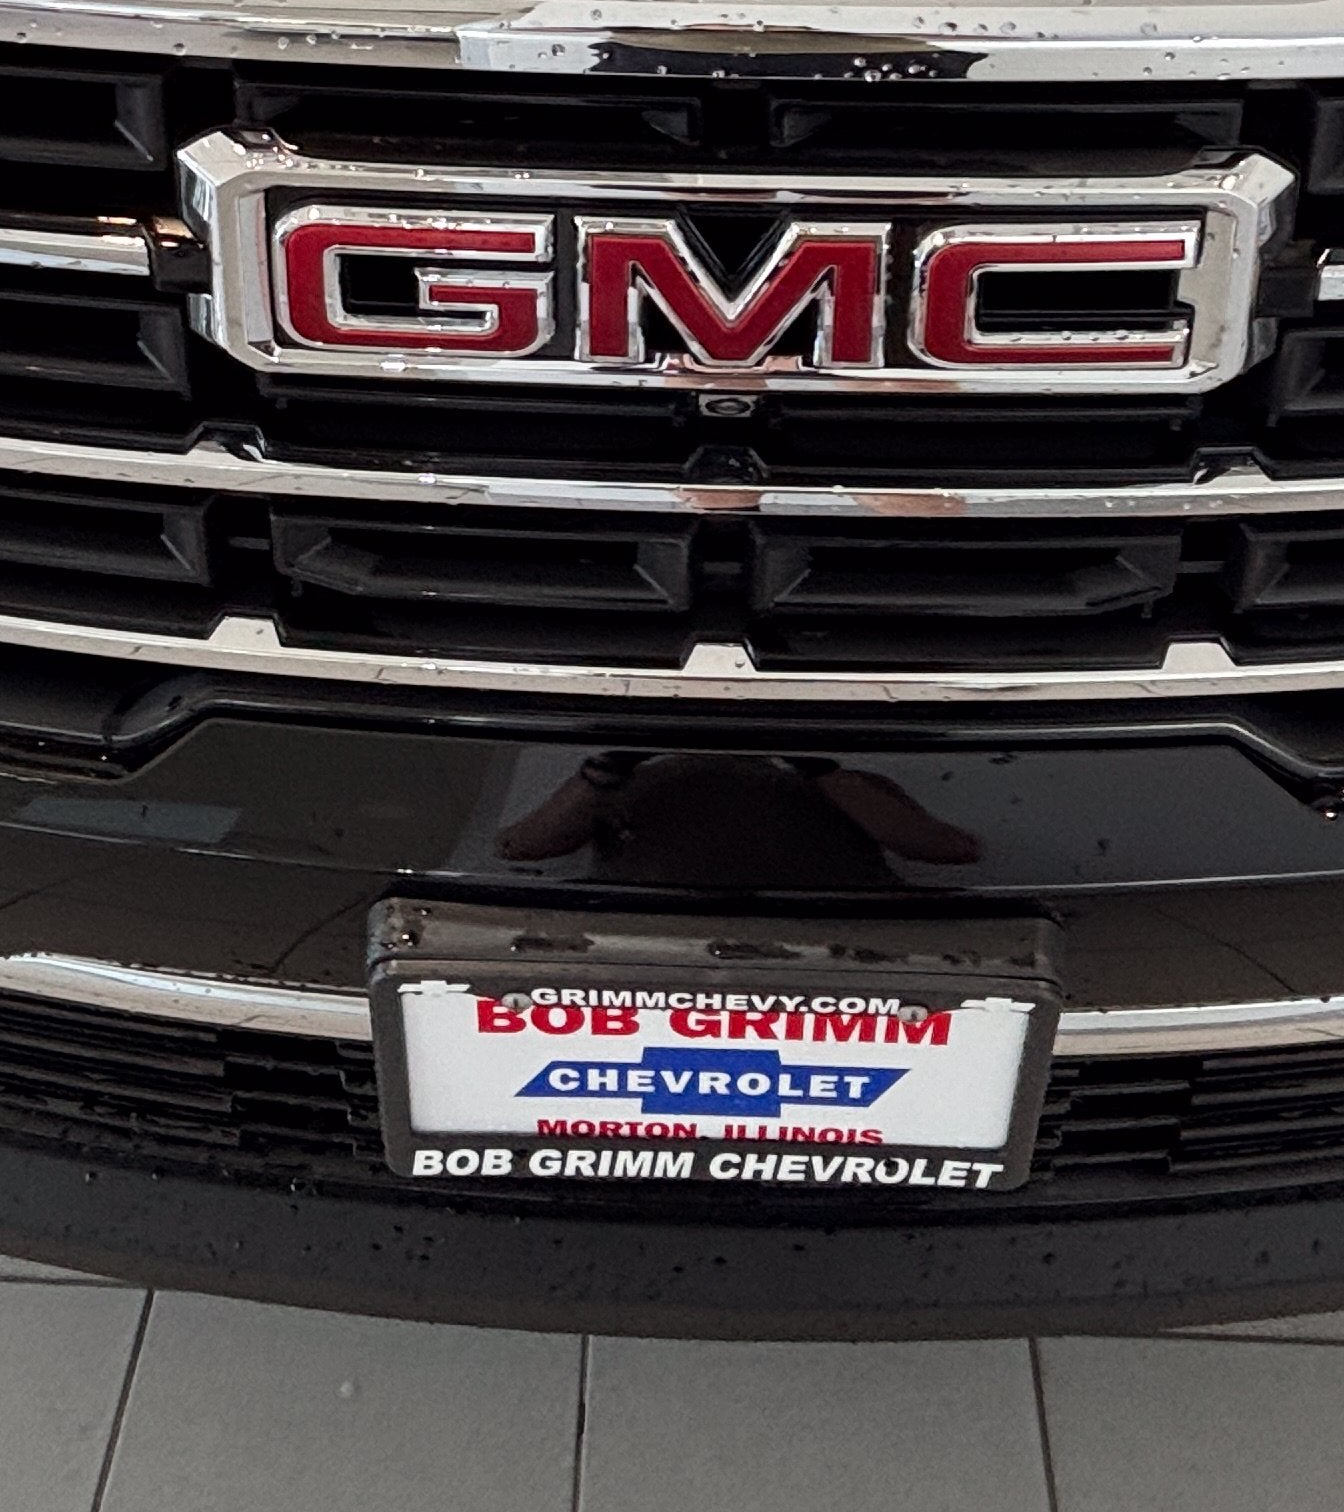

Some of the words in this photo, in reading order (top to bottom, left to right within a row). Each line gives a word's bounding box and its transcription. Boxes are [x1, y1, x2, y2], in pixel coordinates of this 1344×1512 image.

[272, 203, 1203, 370] GMC
[530, 987, 900, 1016] GRIMMCHEVY.COM
[477, 999, 640, 1035] BOB
[669, 1008, 953, 1046] GRIMM
[548, 1067, 871, 1100] CHEVROLET
[724, 1123, 885, 1145] ILLINOIS
[412, 1148, 514, 1177] BOB
[528, 1148, 696, 1179] GRIMM
[709, 1152, 1005, 1188] CHEVROLET
